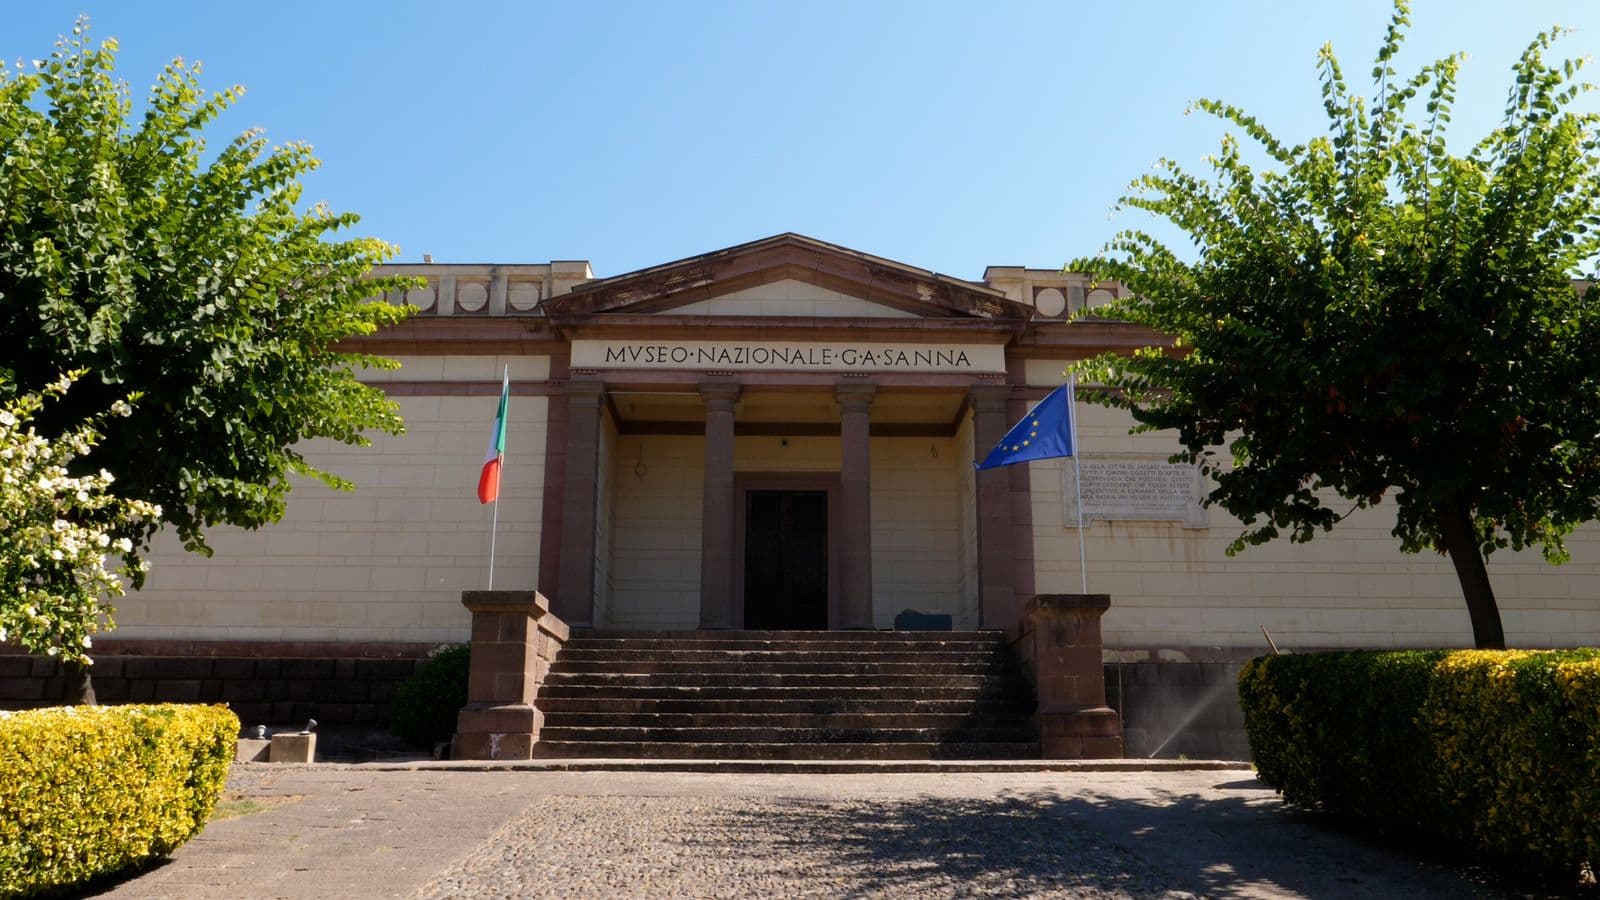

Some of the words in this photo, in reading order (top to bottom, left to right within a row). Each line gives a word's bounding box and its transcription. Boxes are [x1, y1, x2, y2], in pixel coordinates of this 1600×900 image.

[605, 346, 688, 363] MVSEO
[697, 347, 832, 365] NAZIONALE
[883, 349, 971, 366] SANNA
